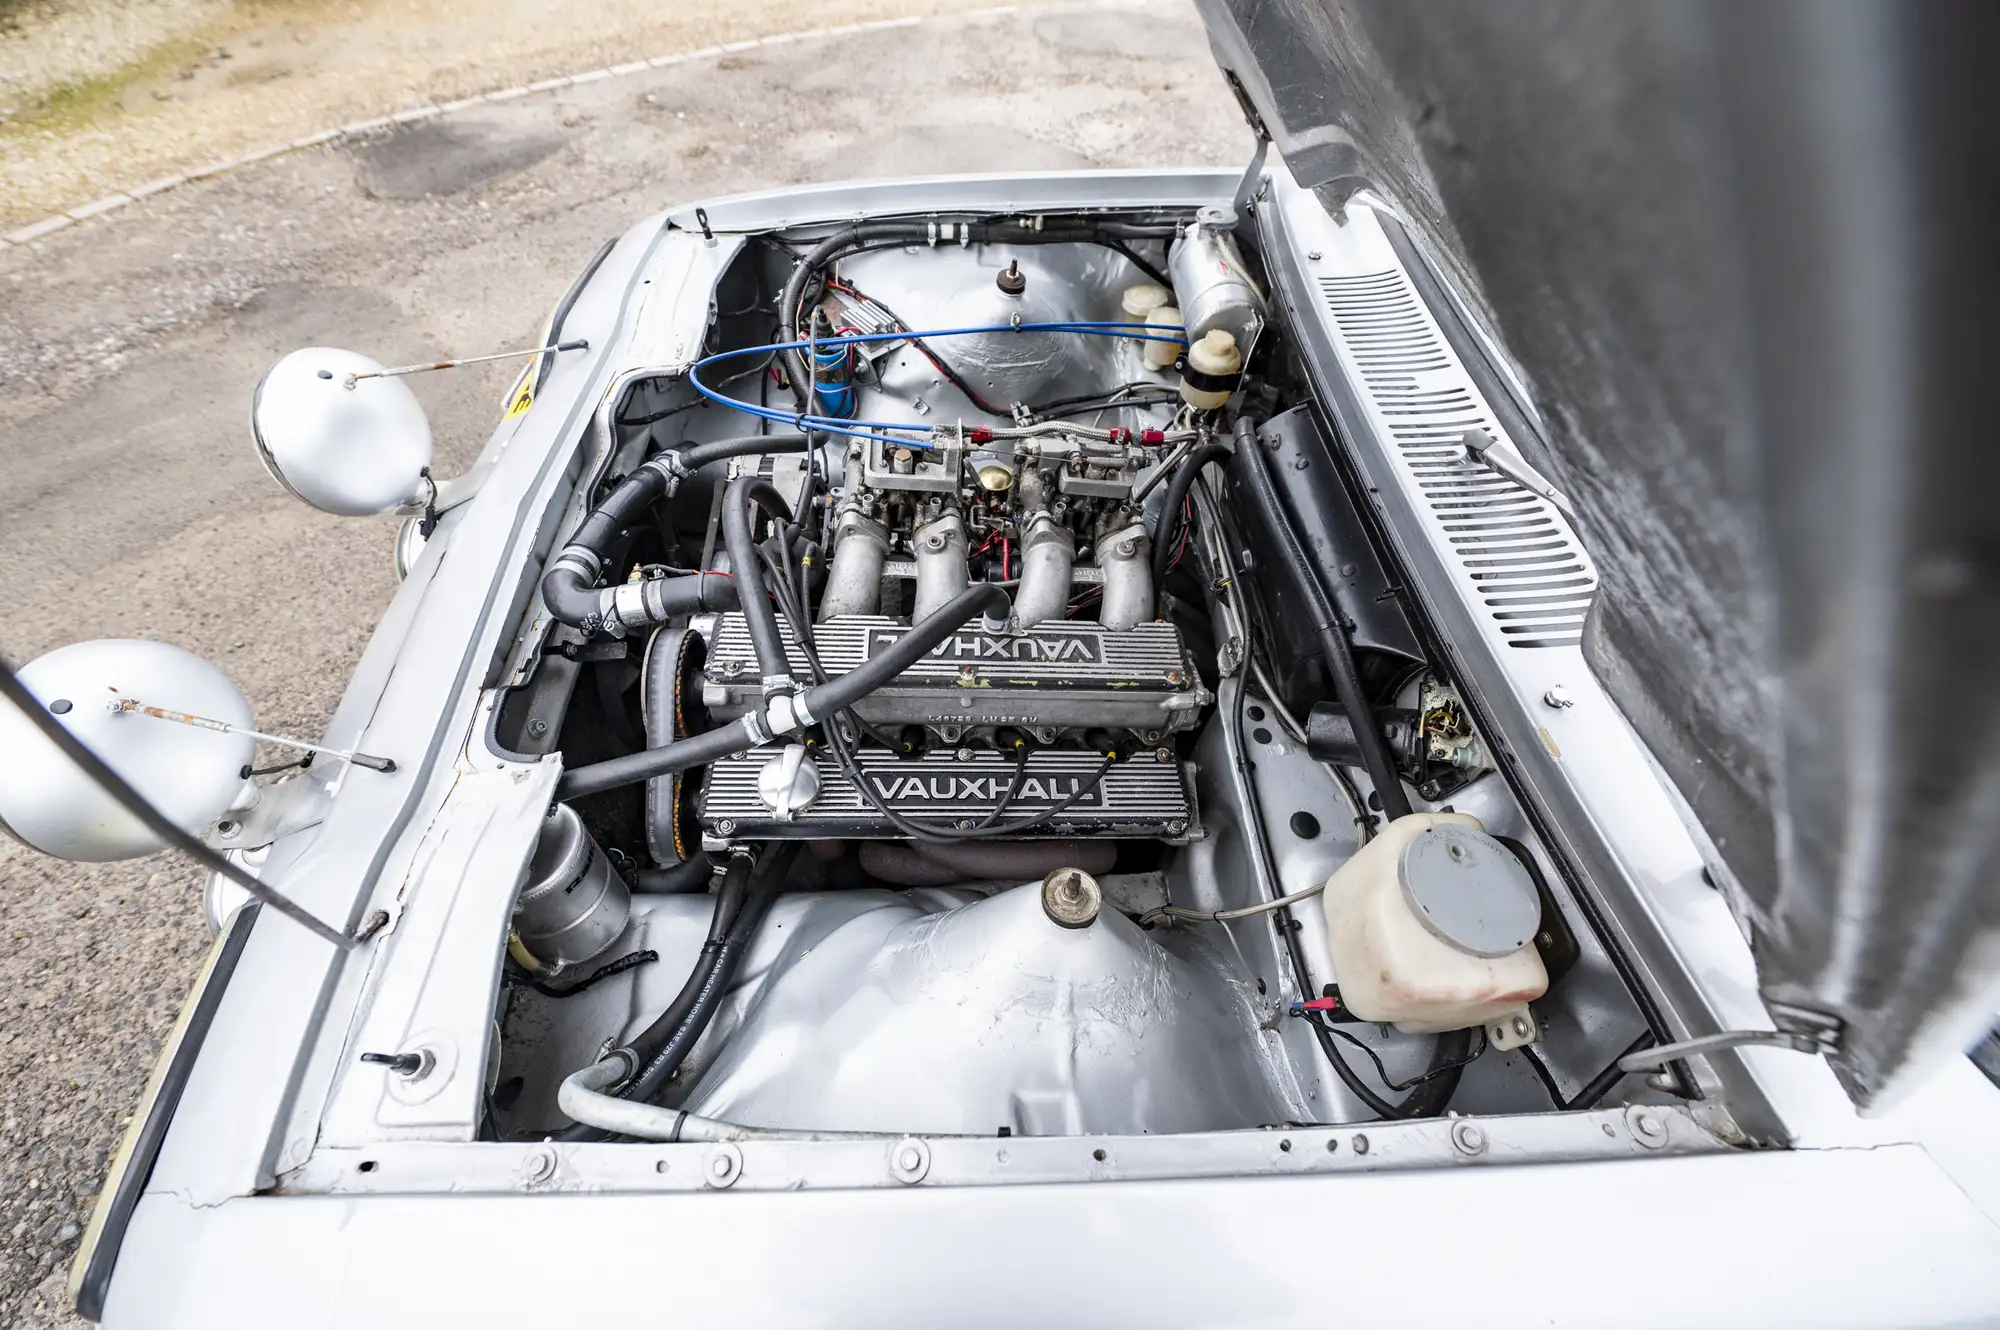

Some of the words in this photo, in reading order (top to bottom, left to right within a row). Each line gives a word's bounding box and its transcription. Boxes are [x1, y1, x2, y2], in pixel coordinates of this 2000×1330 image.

[872, 777, 1094, 800] VAUXHALL
[711, 958, 724, 974] CAR
[697, 974, 717, 1003] HEATER
[684, 1002, 702, 1024] HOSE
[672, 1025, 687, 1042] SAE
[662, 1041, 675, 1055] J20
[653, 1054, 665, 1065] R3
